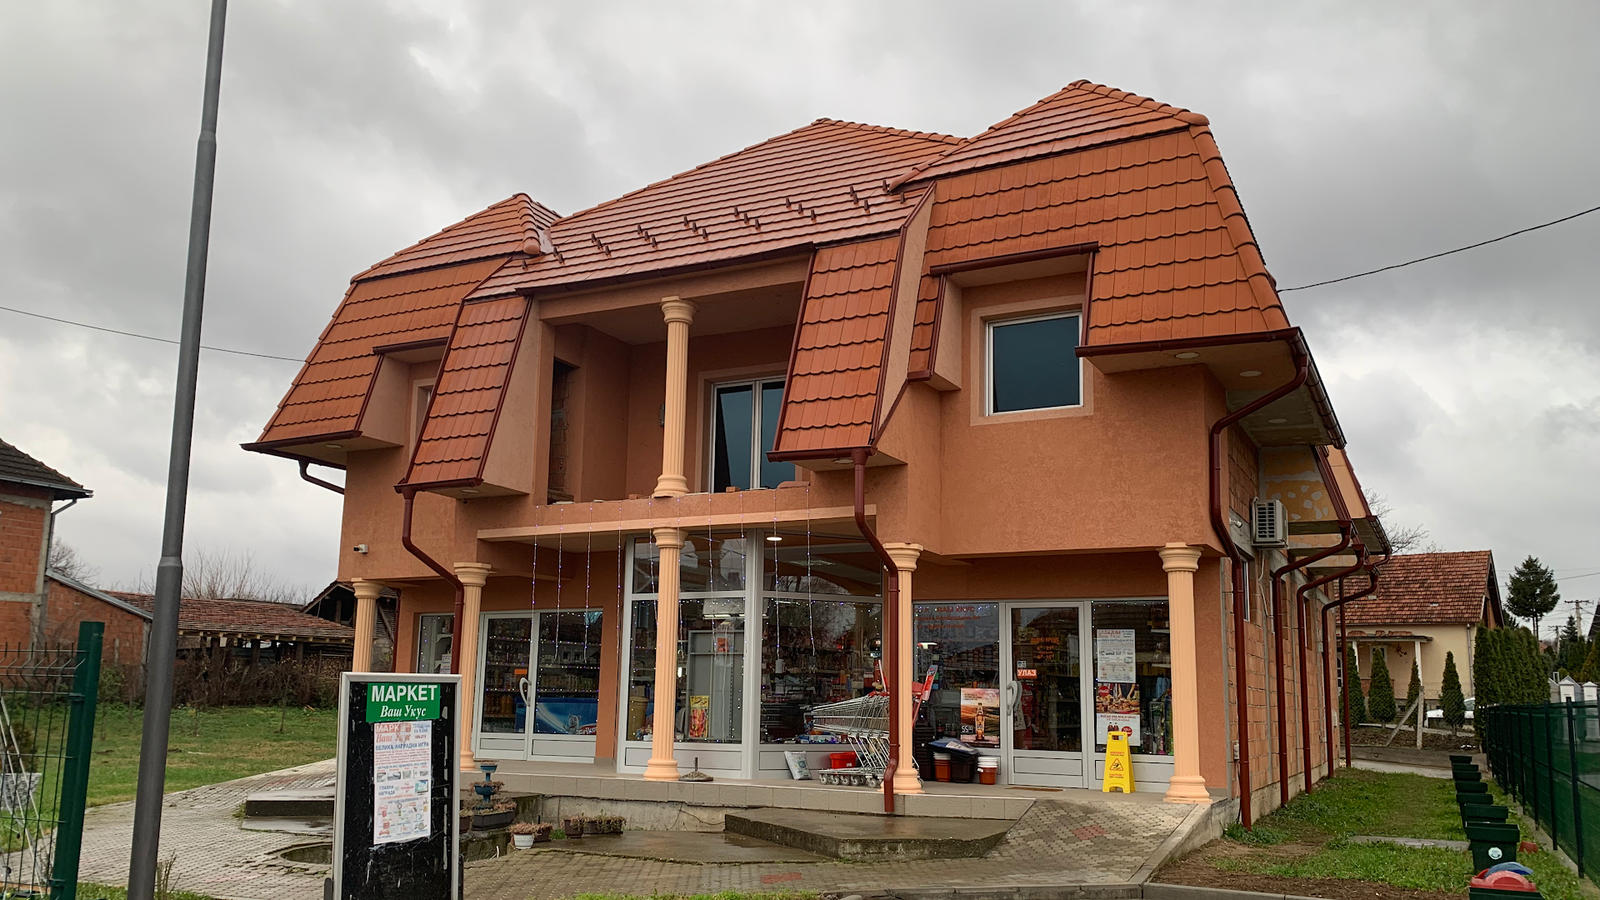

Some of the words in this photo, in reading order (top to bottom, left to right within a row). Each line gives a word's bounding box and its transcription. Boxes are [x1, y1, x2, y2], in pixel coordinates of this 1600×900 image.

[371, 684, 438, 702] МАРКЕТ
[380, 705, 402, 718] Ваш
[404, 704, 427, 719] Укус
